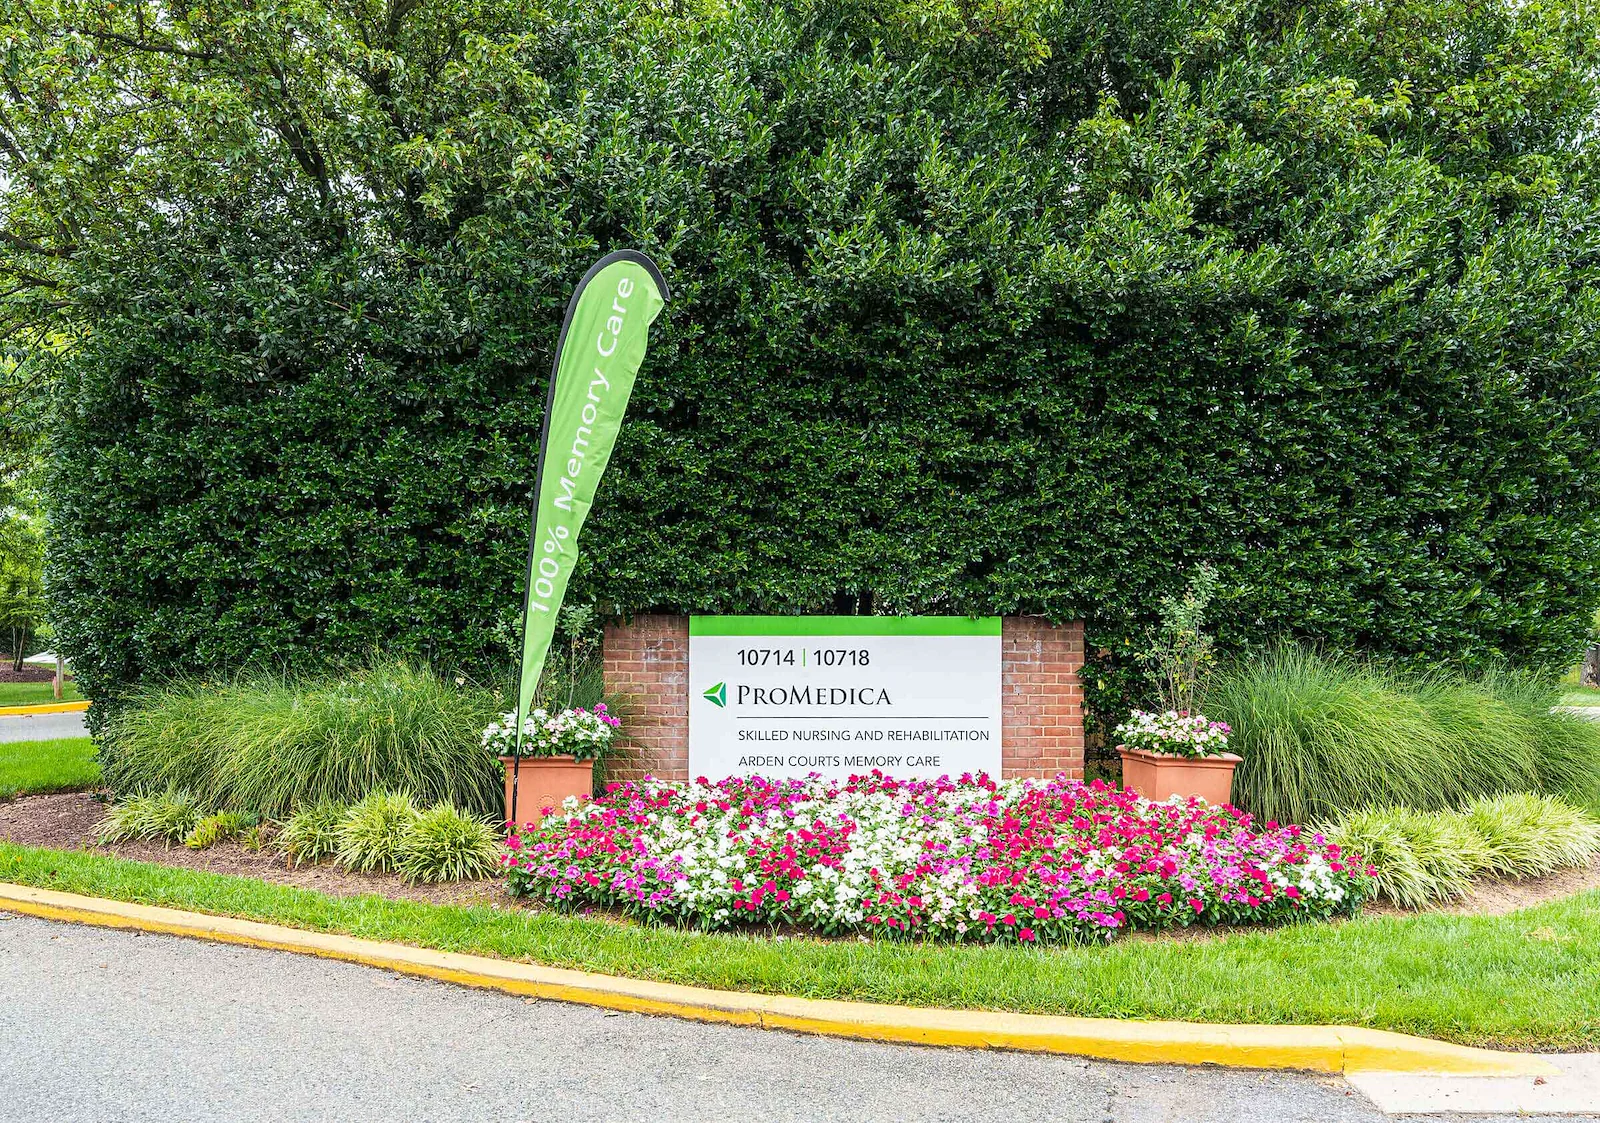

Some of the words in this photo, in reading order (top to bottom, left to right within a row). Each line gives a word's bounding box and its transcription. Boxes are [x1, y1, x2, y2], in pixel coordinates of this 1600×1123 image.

[531, 524, 569, 613] 100%
[554, 367, 610, 512] Memory
[597, 277, 635, 358] Care
[737, 649, 795, 666] 10714
[813, 649, 870, 666] 10718
[738, 729, 789, 742] SKILLED
[792, 729, 851, 742] NURSING
[854, 729, 884, 742] AND
[887, 729, 990, 742] REHABILITATION
[738, 755, 784, 768] ARDEN
[787, 755, 840, 768] COURTS
[843, 755, 903, 768] MEMORY
[906, 755, 941, 768] CARE
